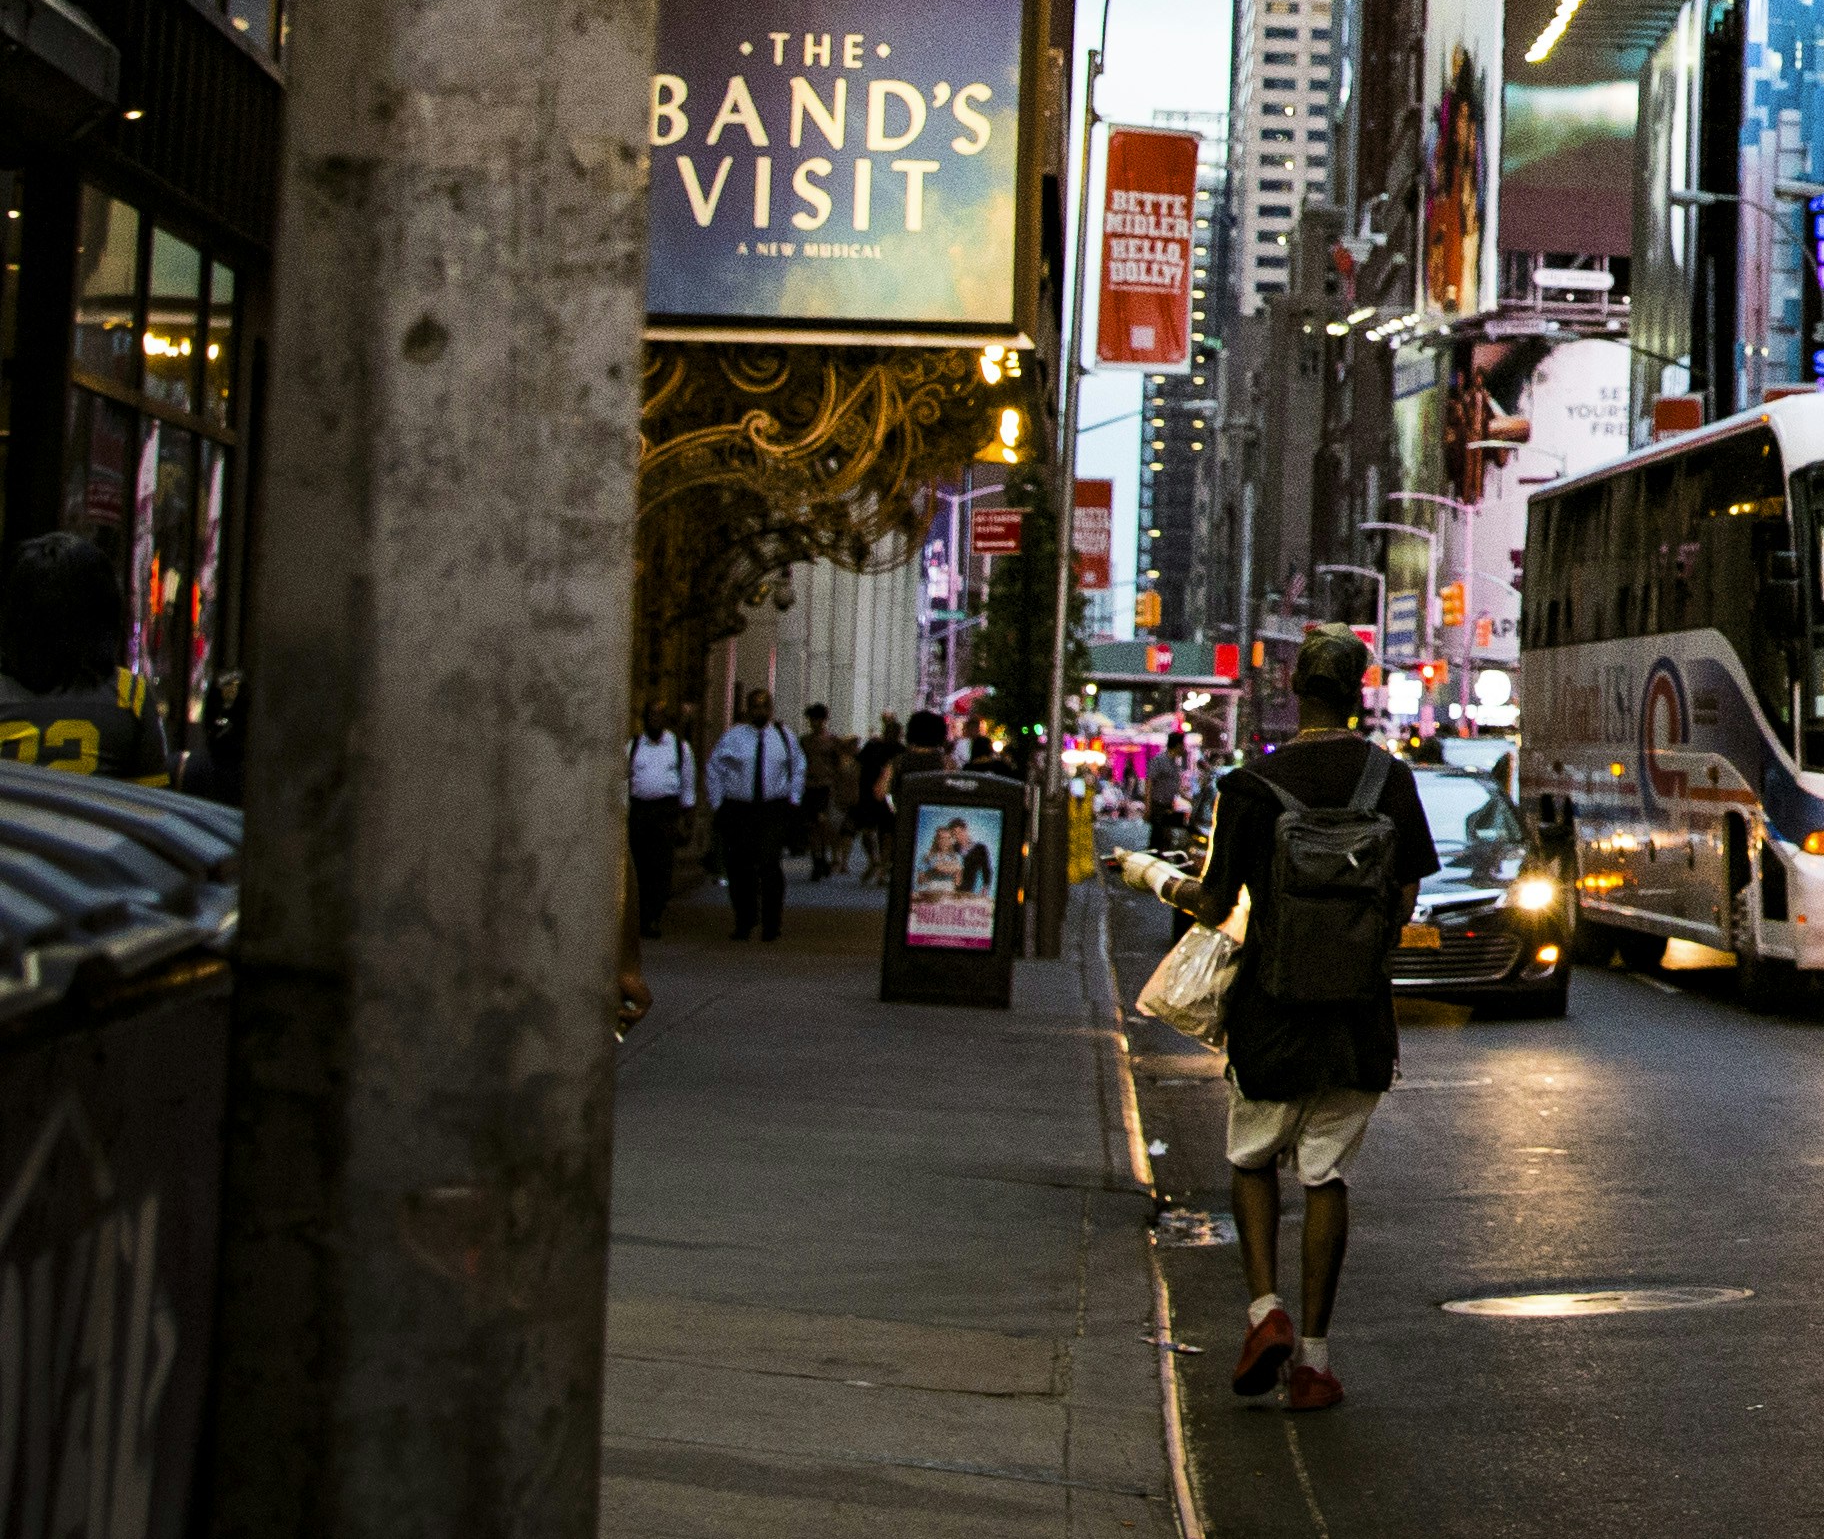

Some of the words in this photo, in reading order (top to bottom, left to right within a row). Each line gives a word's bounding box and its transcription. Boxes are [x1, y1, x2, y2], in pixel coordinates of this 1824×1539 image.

[768, 32, 865, 69] THE
[650, 72, 993, 156] BAND'S
[675, 155, 941, 232] VISIT
[1111, 189, 1188, 218] BETTE
[1105, 211, 1190, 239] MIDLER
[736, 241, 749, 256] A
[756, 242, 797, 259] NEW
[802, 242, 883, 260] MUSICAL
